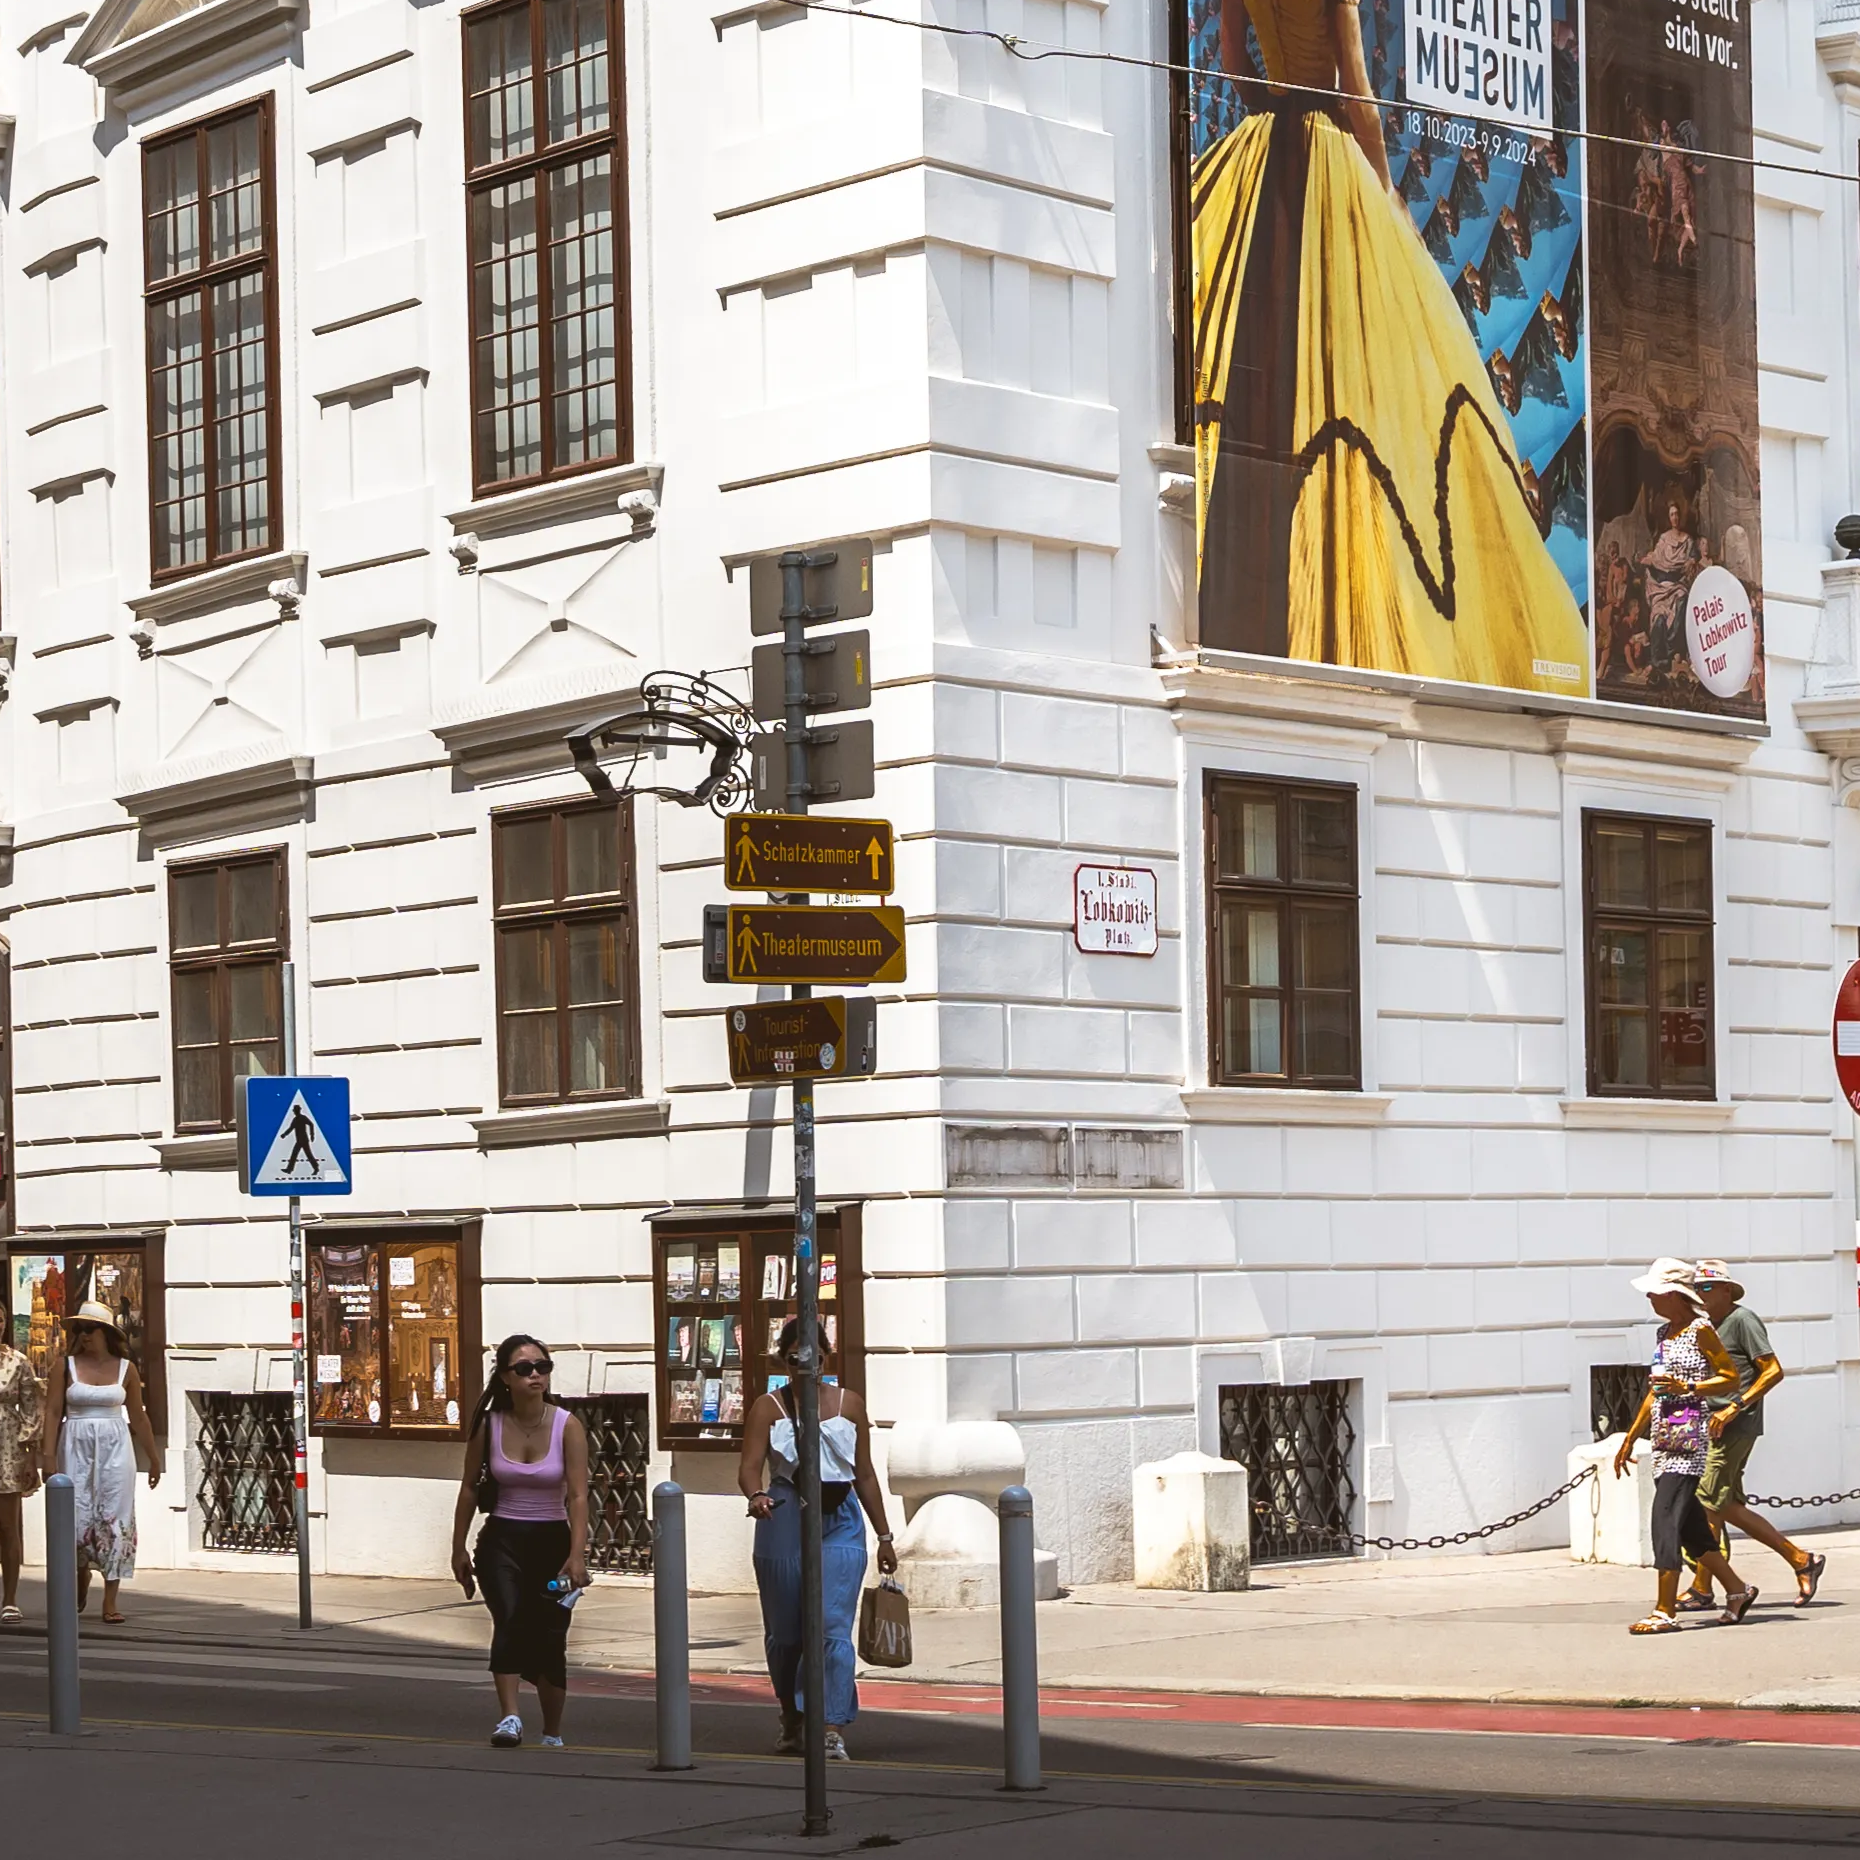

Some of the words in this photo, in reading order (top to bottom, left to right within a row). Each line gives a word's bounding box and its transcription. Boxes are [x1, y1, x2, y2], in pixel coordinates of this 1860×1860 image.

[1664, 14, 1700, 59] sich
[1705, 33, 1738, 70] vor.
[1406, 111, 1537, 168] 18.10.2023-9.9.2024
[1692, 595, 1724, 627] Palais
[1699, 612, 1748, 652] Lobkowitz
[1704, 653, 1728, 678] Tour
[762, 840, 862, 865] Schatzkammer
[761, 931, 883, 957] Theatermuseum
[763, 1014, 809, 1037] Tourist-
